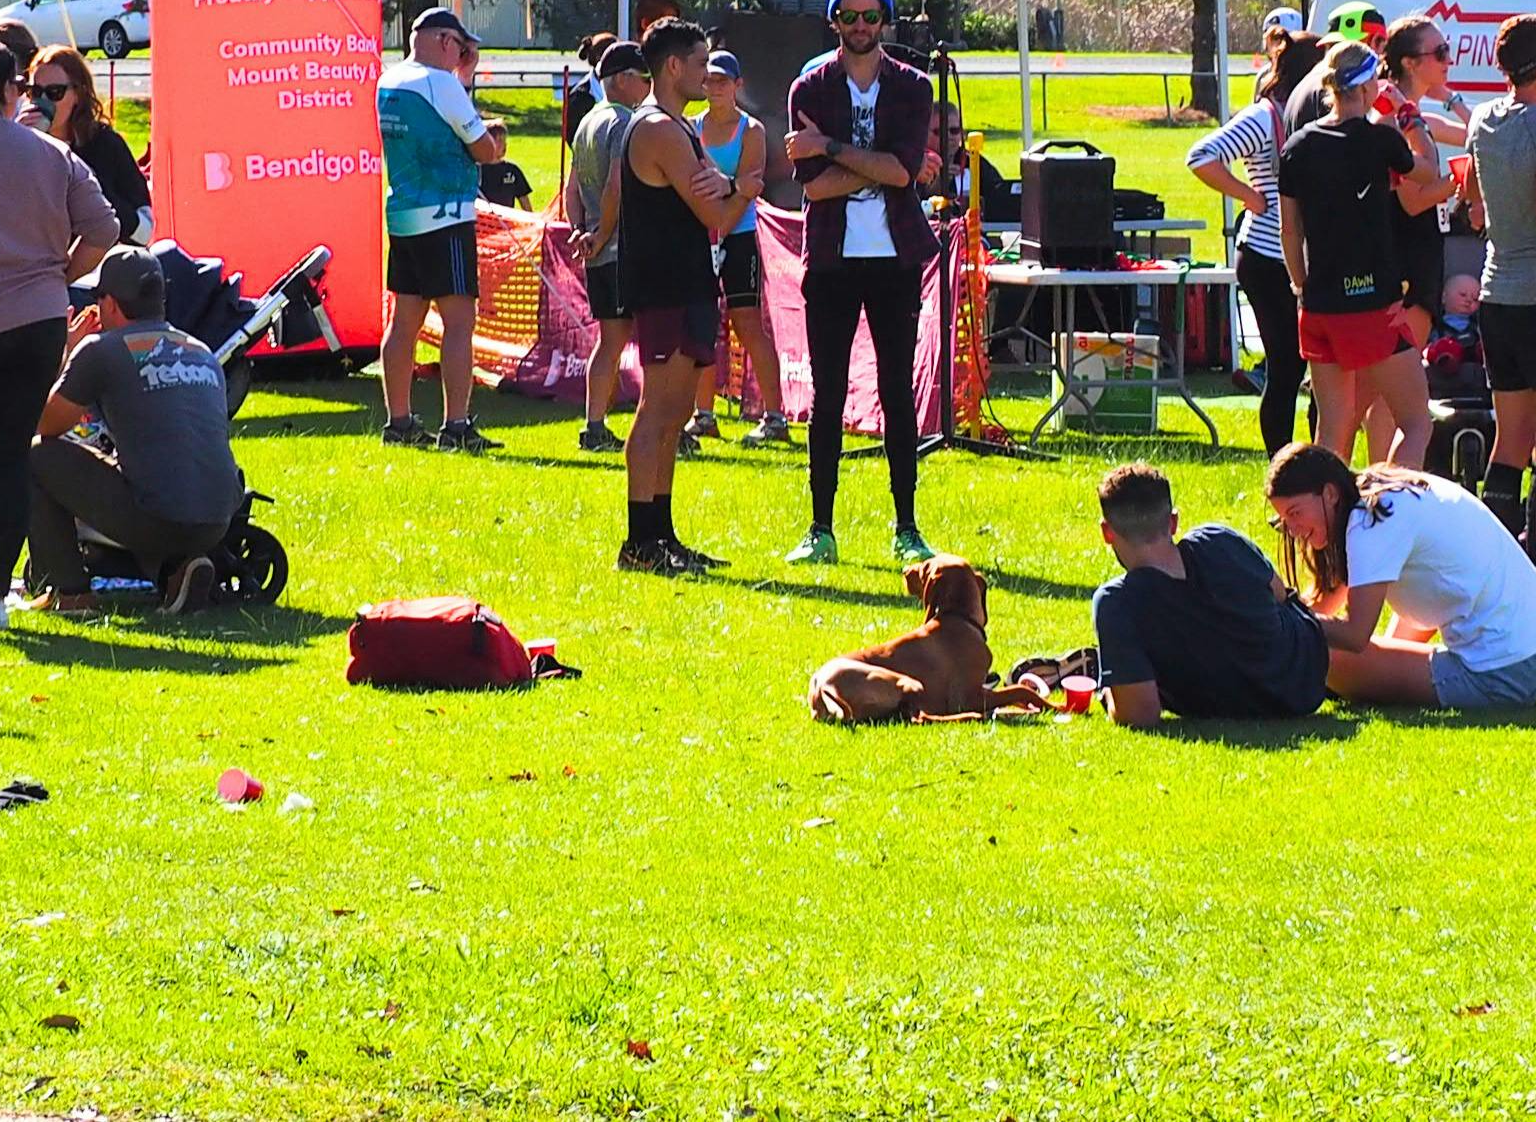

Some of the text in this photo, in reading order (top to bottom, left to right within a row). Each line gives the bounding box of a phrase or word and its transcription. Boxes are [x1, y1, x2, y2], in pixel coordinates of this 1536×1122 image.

[219, 32, 342, 59] Community
[228, 64, 299, 87] Mount
[305, 61, 367, 83] Beauty
[278, 87, 353, 110] District
[246, 148, 355, 182] Bendigo
[1344, 273, 1374, 289] DAWN
